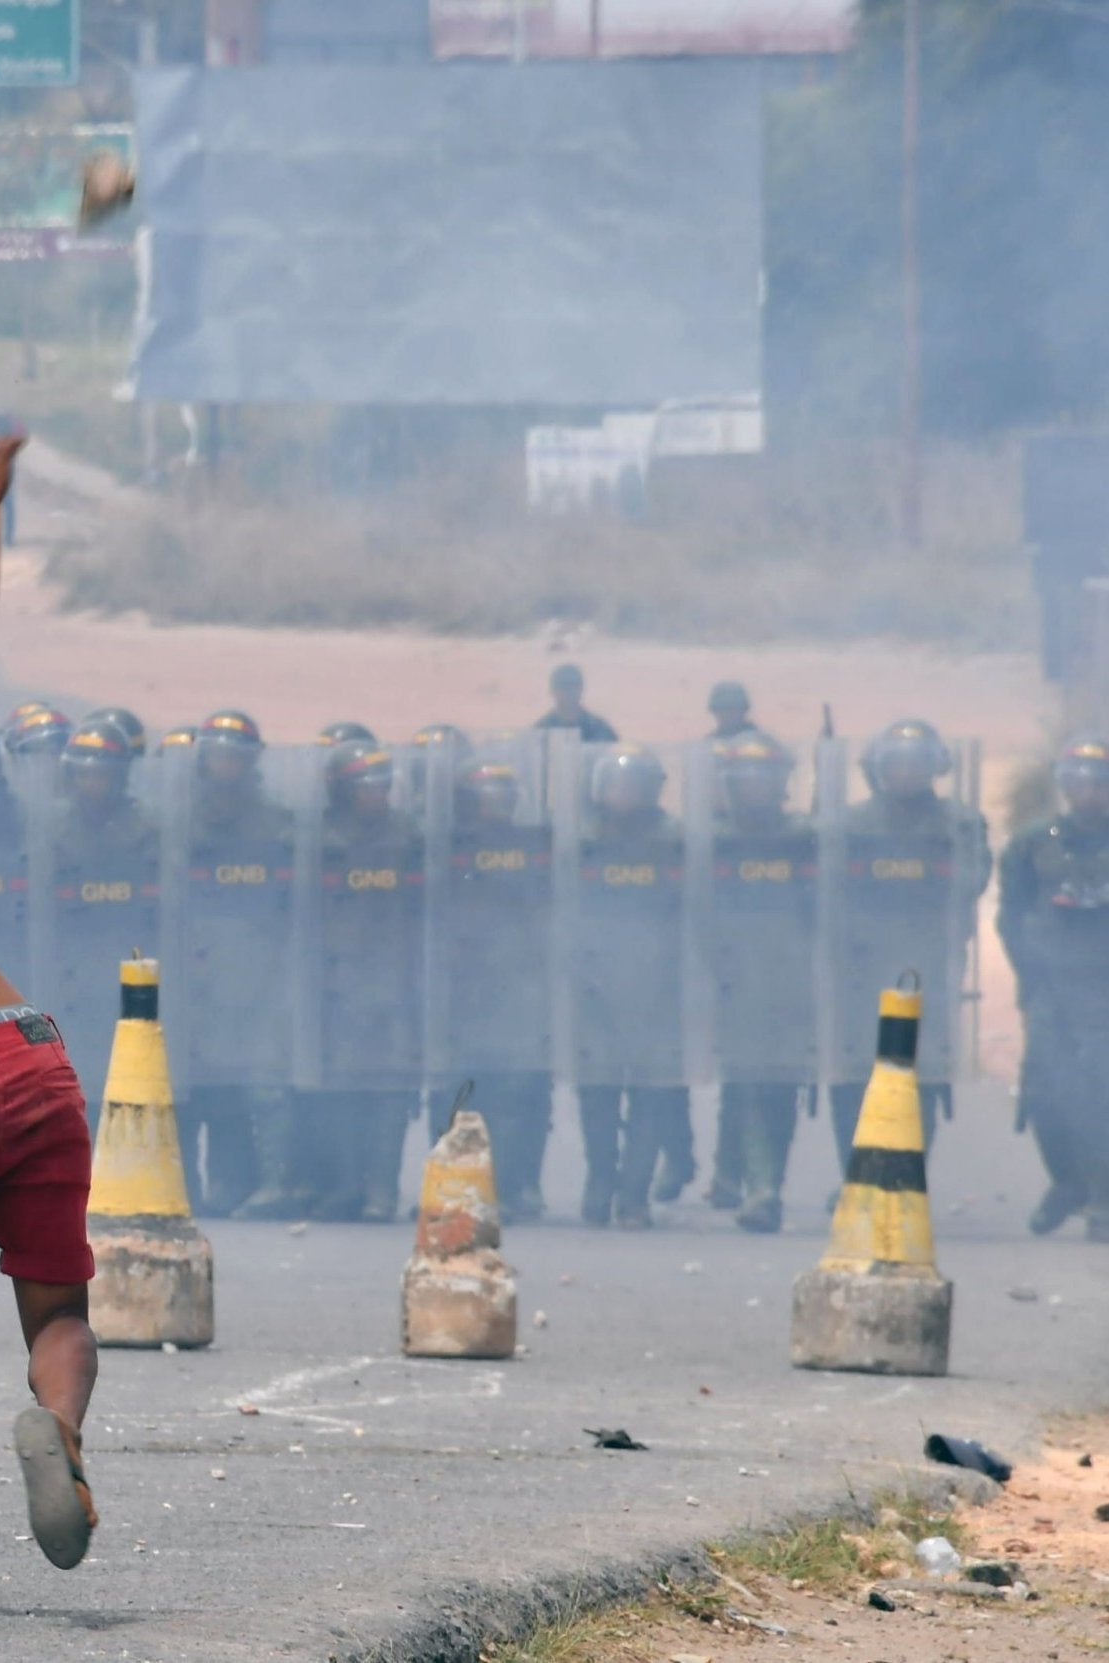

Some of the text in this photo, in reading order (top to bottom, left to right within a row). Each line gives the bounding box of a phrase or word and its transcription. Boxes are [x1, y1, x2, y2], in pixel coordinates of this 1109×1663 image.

[475, 849, 528, 870] GNB
[739, 859, 792, 881] GNB
[872, 859, 925, 880] GNB
[216, 864, 267, 885] GNB
[348, 869, 398, 890] GNB
[605, 865, 656, 885] GNB
[81, 881, 133, 902] GNB
